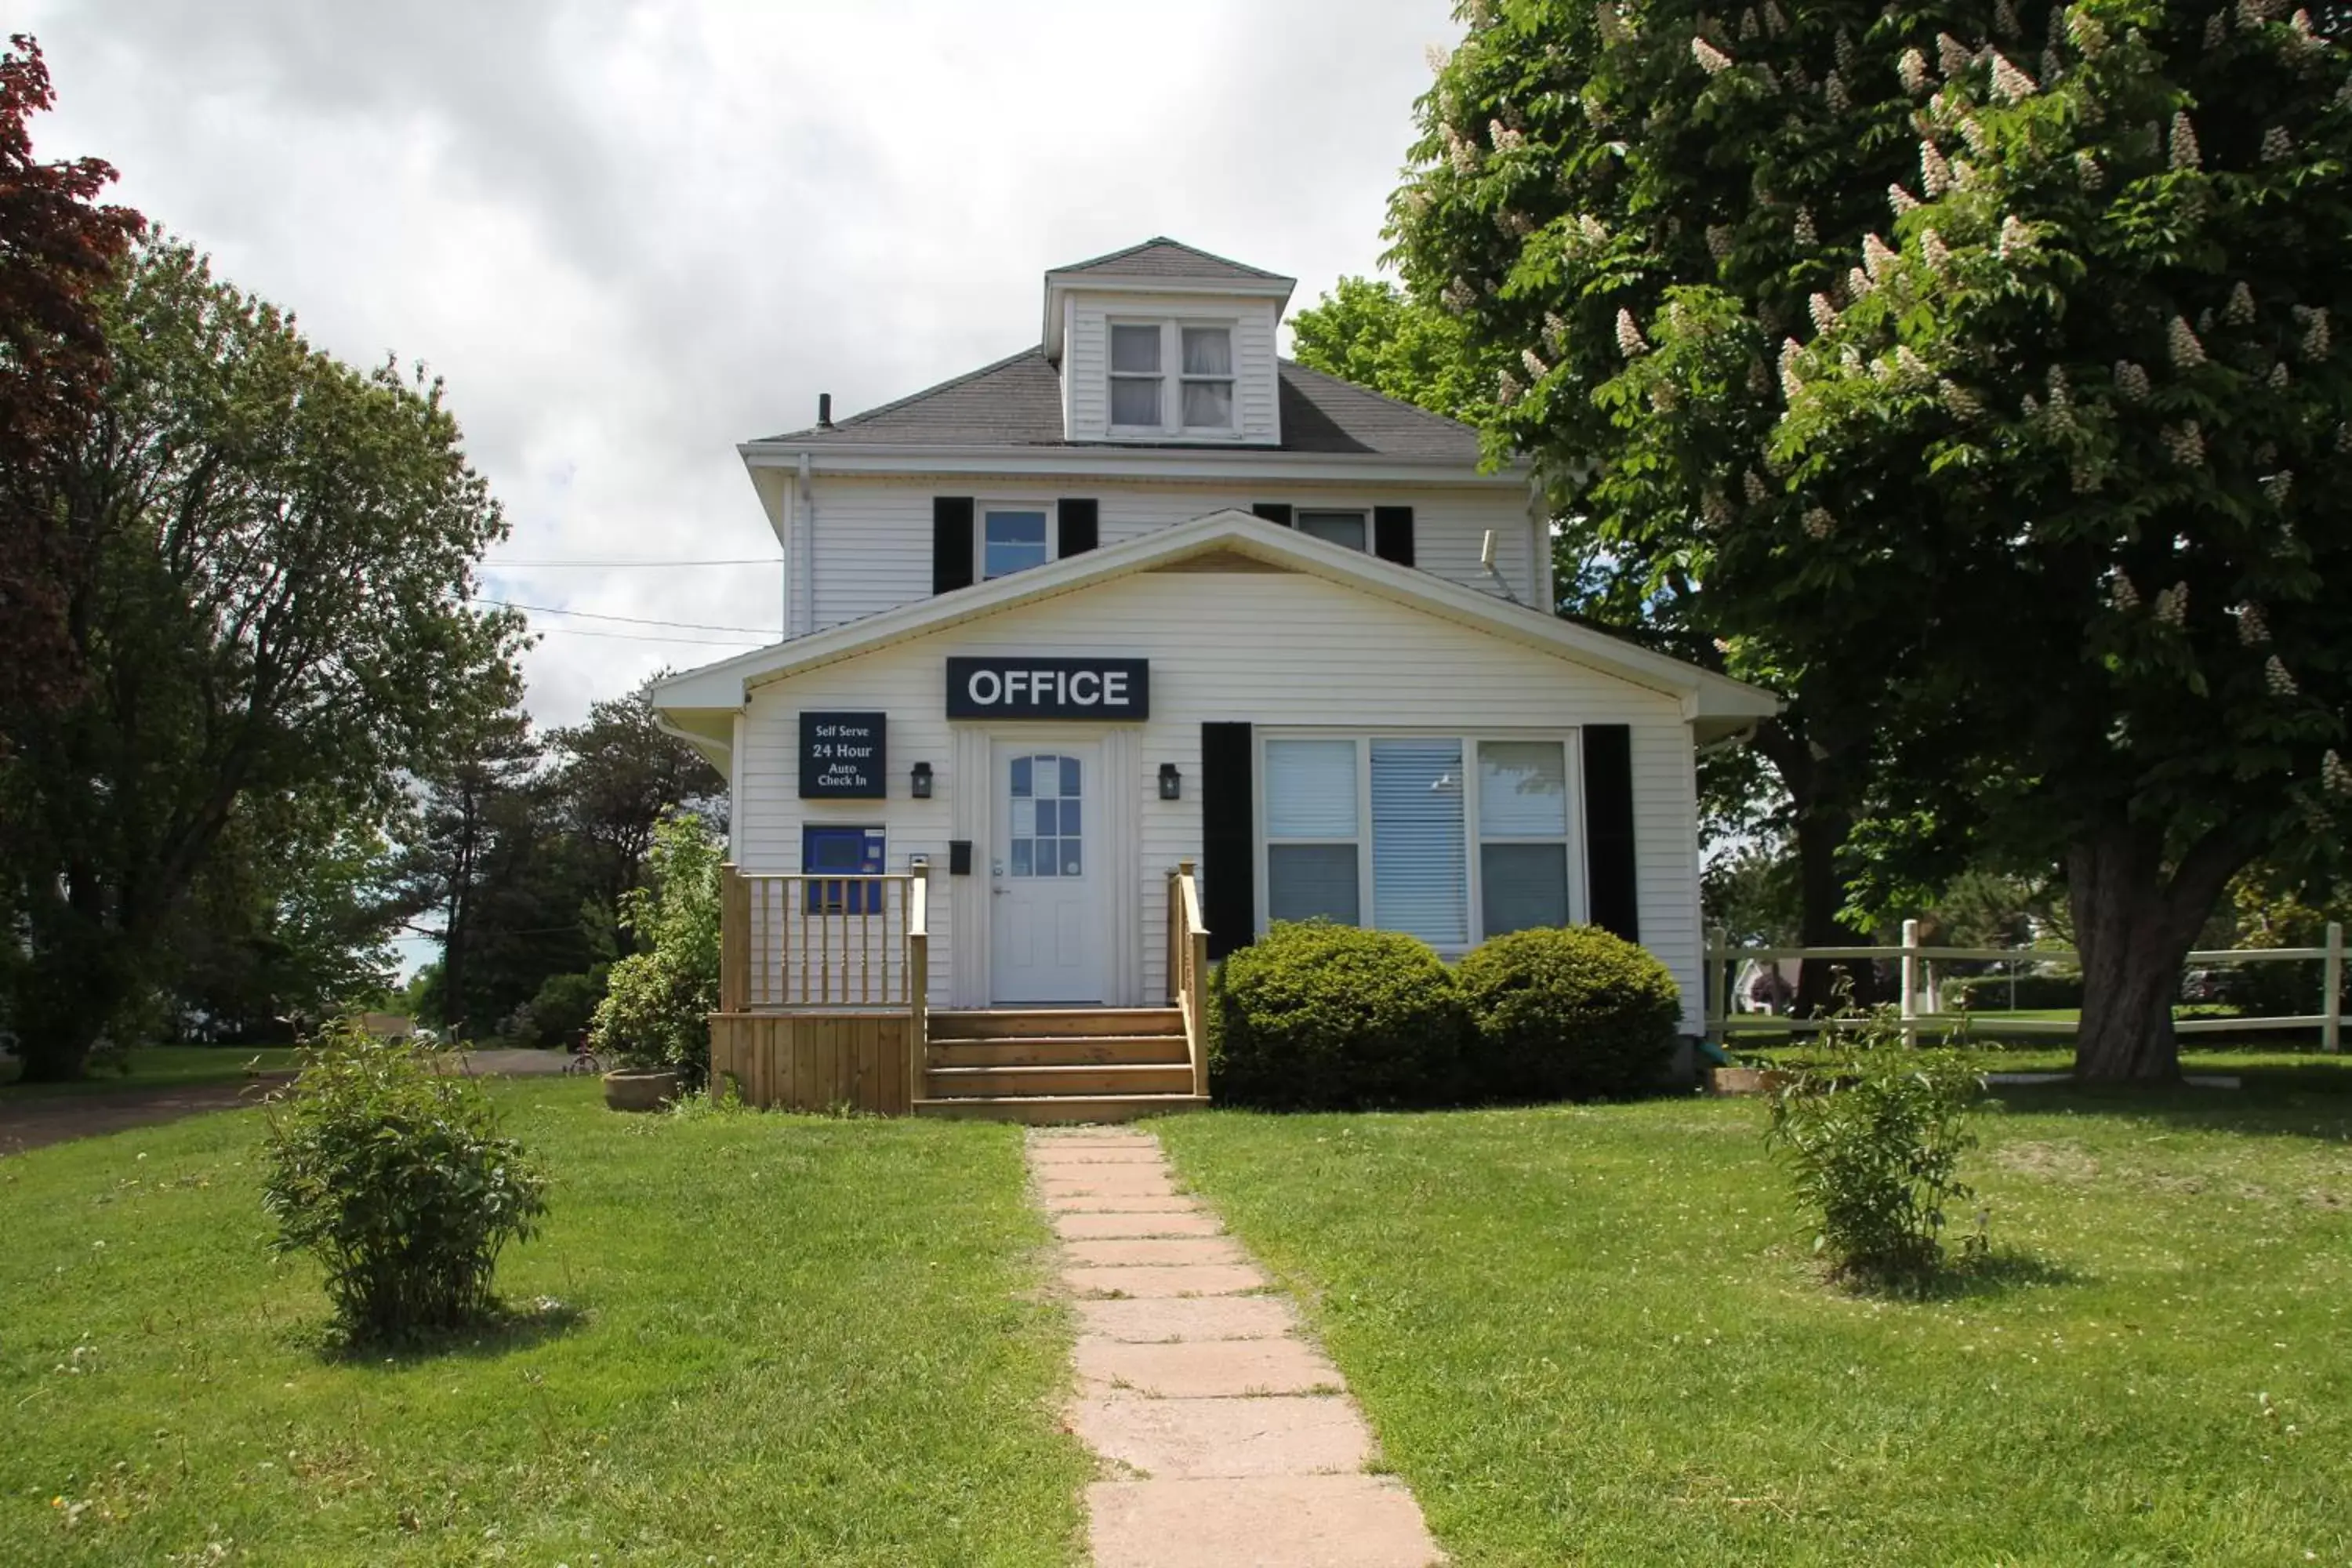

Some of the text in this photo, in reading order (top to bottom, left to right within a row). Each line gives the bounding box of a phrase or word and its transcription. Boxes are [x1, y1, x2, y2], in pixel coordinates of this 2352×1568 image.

[968, 670, 1130, 705] OFFICE
[816, 725, 869, 736] Self Serve
[812, 743, 873, 757] 24 Hour
[829, 763, 857, 774] Auto
[818, 774, 867, 786] Check In
